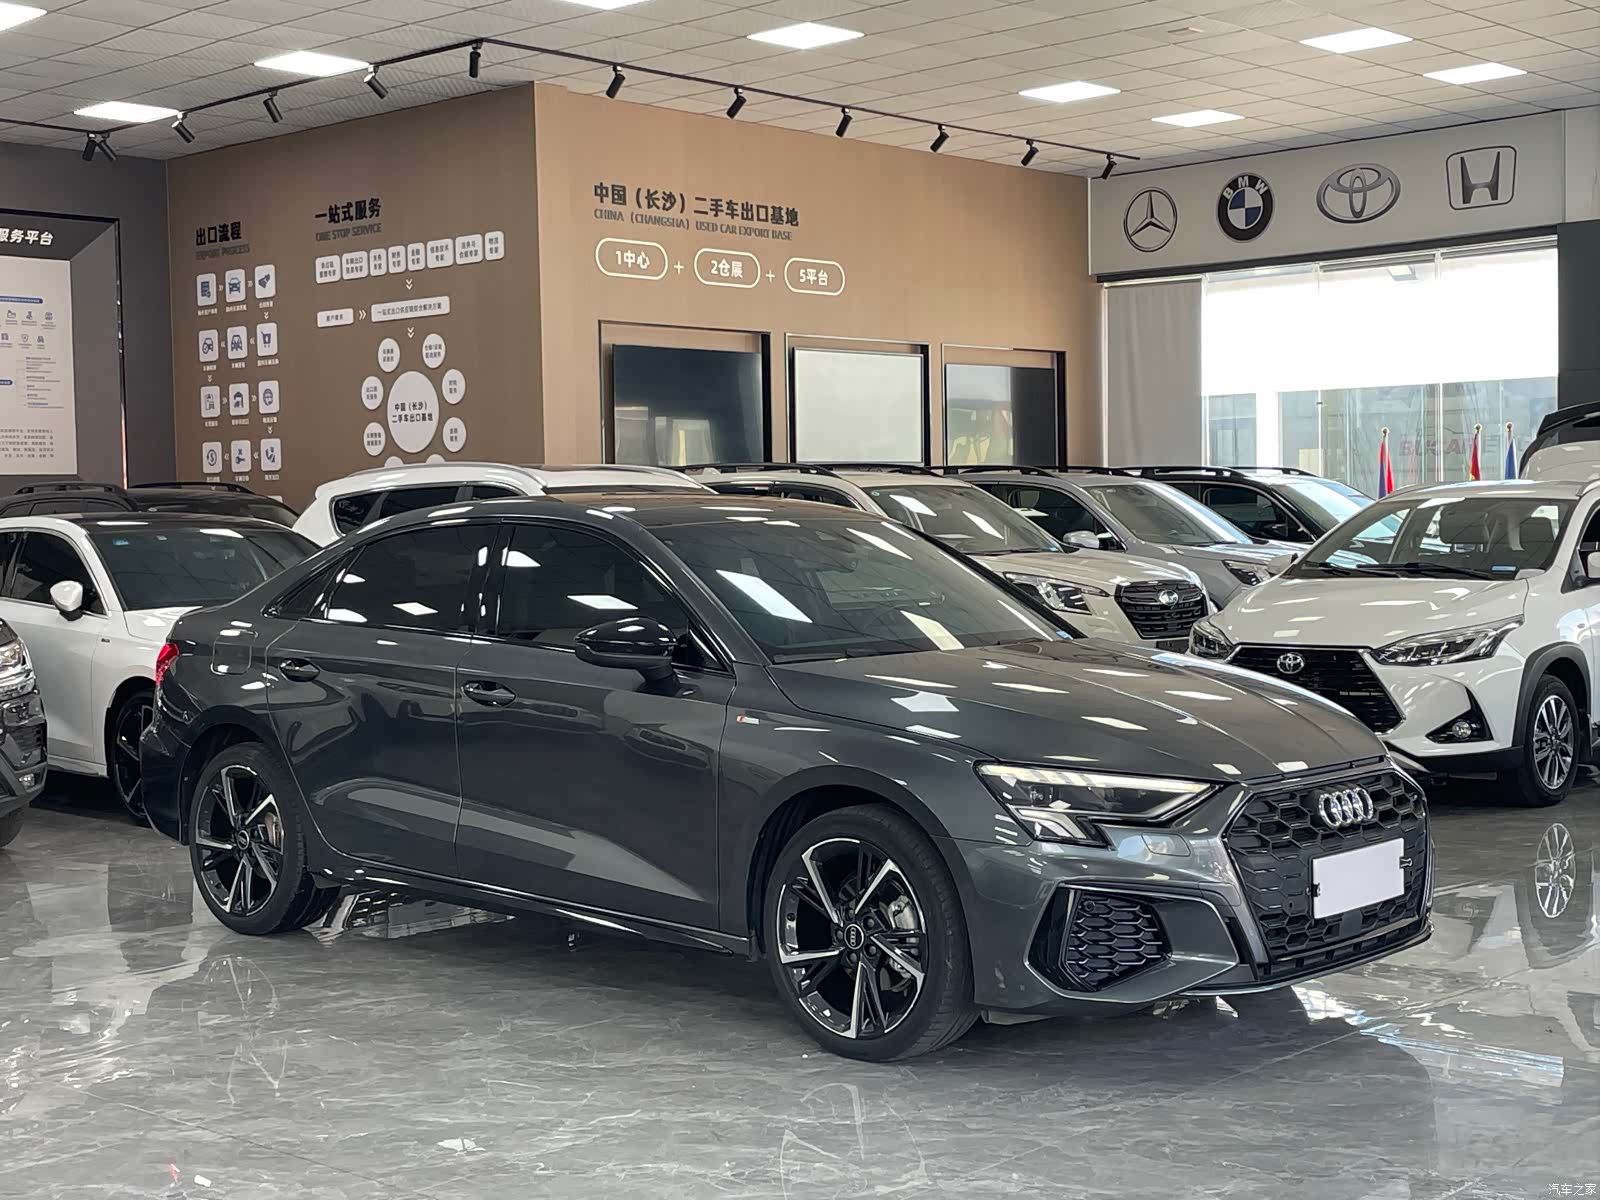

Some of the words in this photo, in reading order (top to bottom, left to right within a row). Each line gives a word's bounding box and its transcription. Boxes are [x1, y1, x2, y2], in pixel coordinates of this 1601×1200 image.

[1222, 176, 1268, 200] BMW
[315, 198, 381, 224] 一站式服务
[594, 182, 799, 226] 中国（长沙）二手车出口基地
[196, 221, 242, 246] 出口流程
[332, 227, 350, 240] STOP
[352, 223, 382, 236] SERVICE
[594, 208, 624, 222] CHINA
[696, 220, 718, 232] USED
[720, 223, 737, 235] CAR
[738, 226, 770, 239] EXPORT
[772, 229, 793, 241] BASE
[615, 250, 650, 269] 1中心
[711, 259, 743, 279] 2仓展
[799, 268, 829, 286] 5平台
[394, 400, 428, 412] 中国（长沙）
[391, 413, 434, 424] 二手车出口基地
